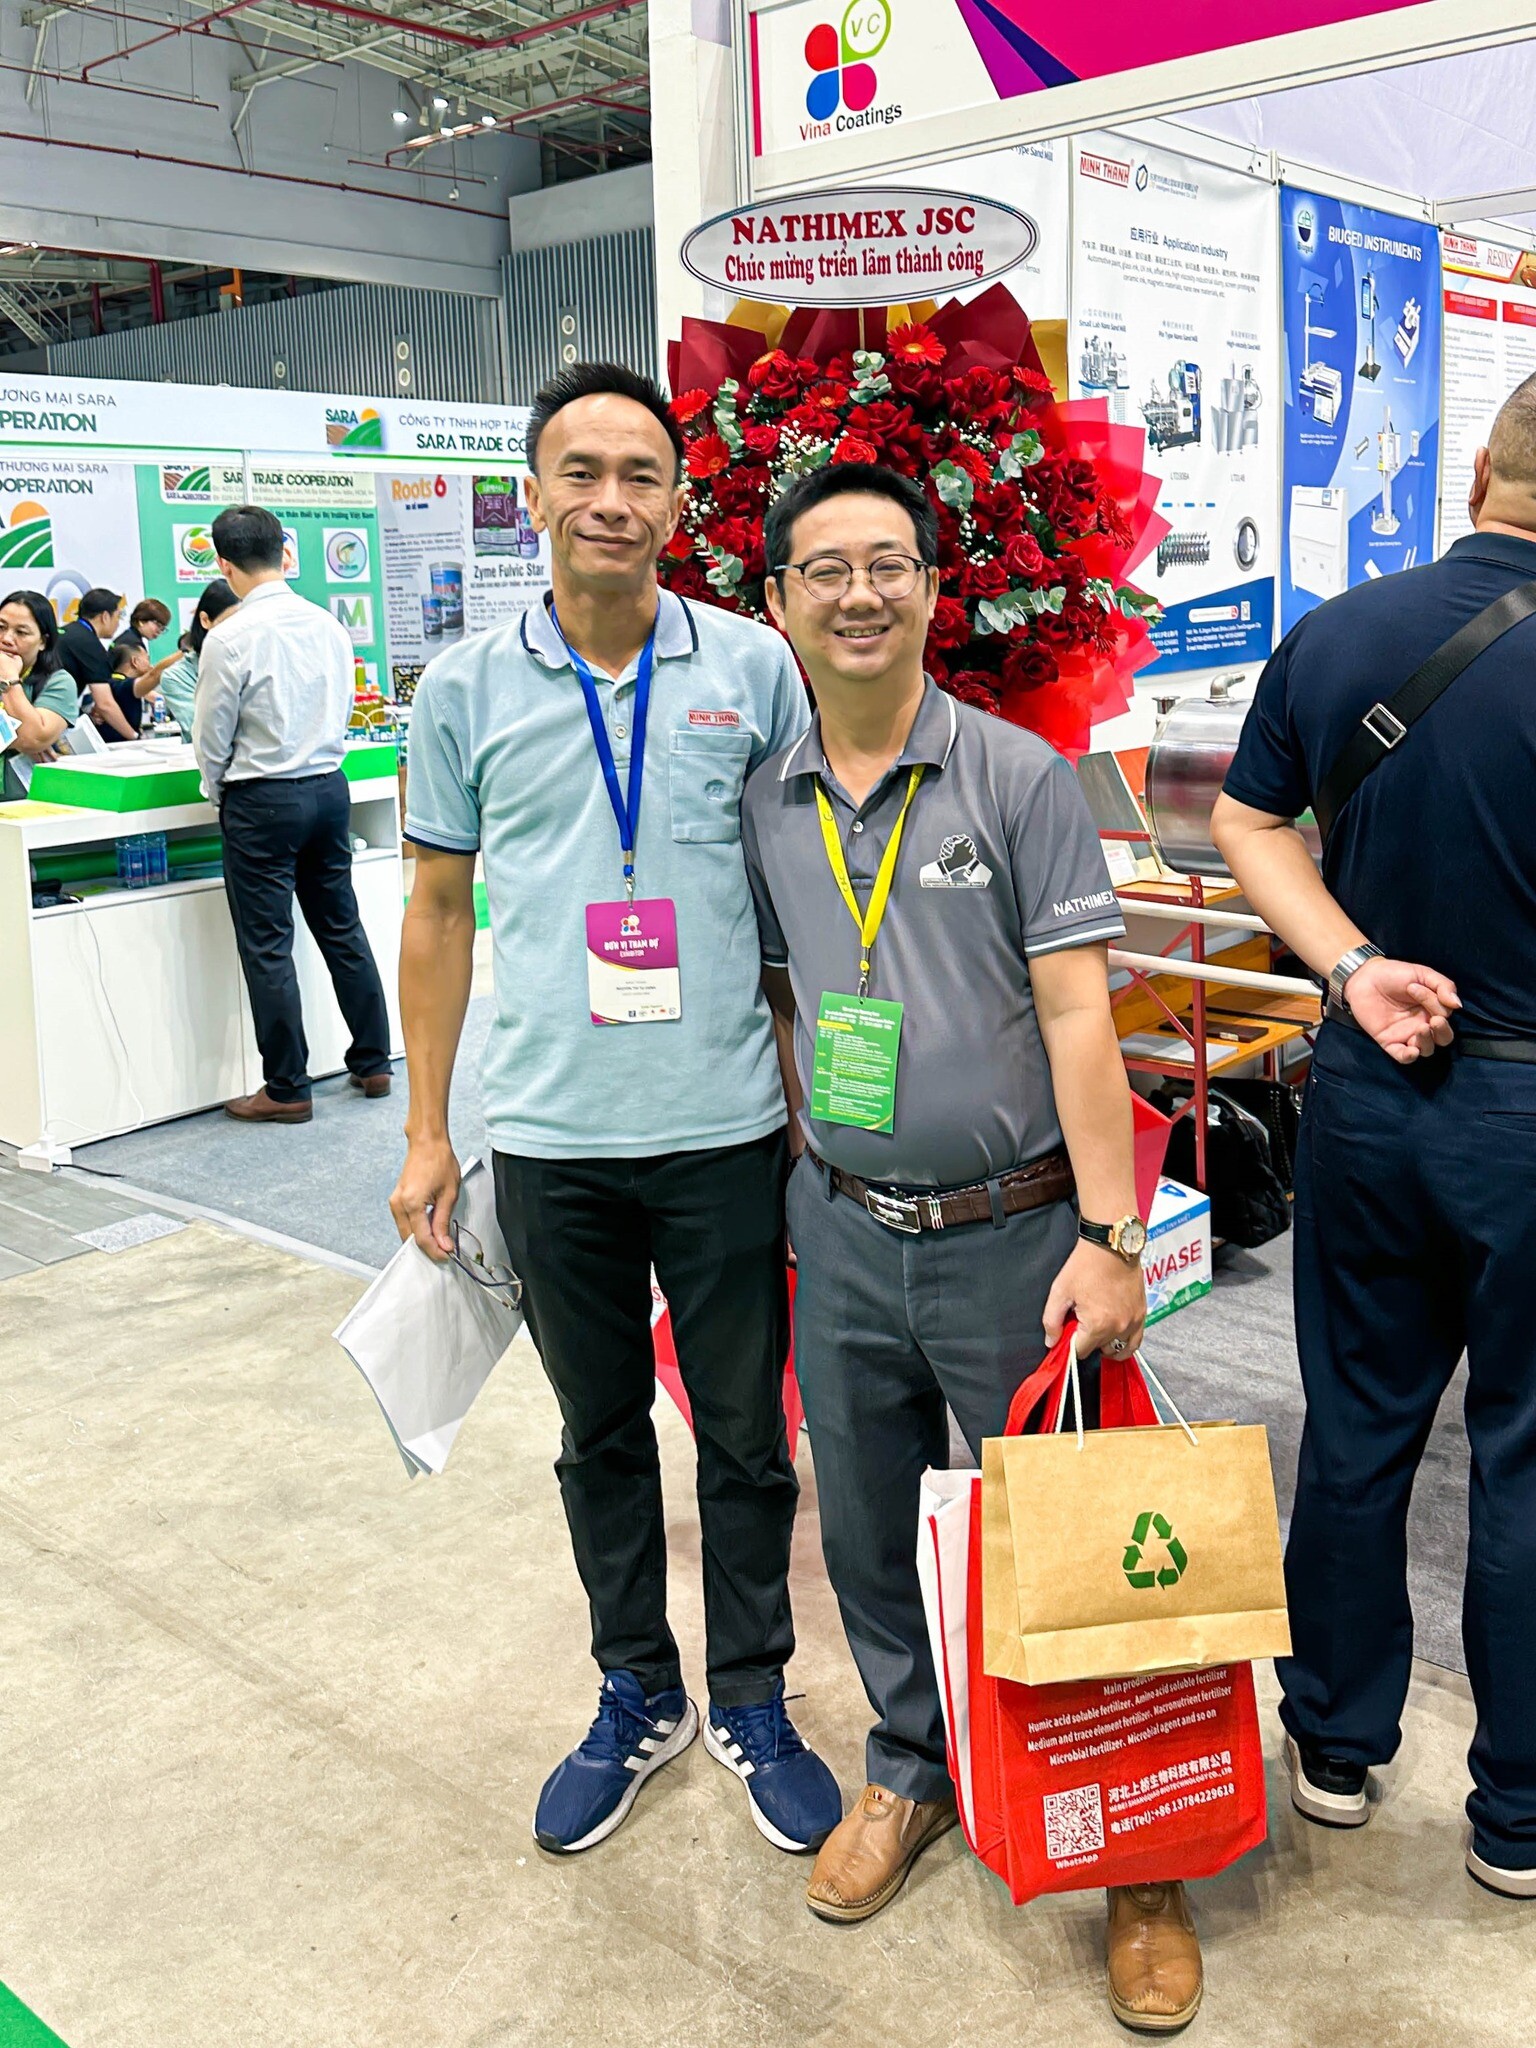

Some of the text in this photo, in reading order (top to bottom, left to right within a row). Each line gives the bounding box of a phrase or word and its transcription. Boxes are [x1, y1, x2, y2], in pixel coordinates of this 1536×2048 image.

[799, 103, 903, 142] Vina Coatings
[1081, 156, 1100, 175] MINH
[1103, 164, 1129, 184] THANH
[731, 206, 976, 245] NATHIMEX JSC
[1163, 235, 1200, 253] Application
[1328, 225, 1422, 262] BIUGED INSTRUMENTS
[725, 240, 984, 285] Chúc mừng triển lãm thành công
[1487, 248, 1514, 269] RESINS
[45, 391, 73, 407] MẠI
[77, 393, 117, 408] SARA
[326, 408, 359, 425] SARA
[399, 412, 524, 432] CÔNG TY TNHH HỢP TÁC
[417, 433, 457, 451] SARA
[460, 435, 503, 452] TRADE
[52, 462, 74, 475] MẠI
[77, 463, 109, 475] SARA
[223, 471, 354, 488] SAR TRADE COOPERATION
[391, 477, 433, 501] Roots
[434, 474, 447, 498] 6
[474, 563, 544, 580] Zyme Fulvic Star
[1053, 890, 1117, 917] NATHIMEX
[1145, 1239, 1202, 1285] WASE
[1028, 1718, 1053, 1733] Humic
[1054, 1714, 1071, 1727] acid
[1072, 1707, 1099, 1723] soluble
[1169, 1676, 1195, 1692] soluble
[1196, 1669, 1227, 1684] fertilizer
[1103, 1682, 1122, 1696] Main
[1027, 1738, 1058, 1752] Medium
[1058, 1732, 1073, 1744] and
[1074, 1728, 1093, 1742] trace
[1093, 1720, 1122, 1736] element
[1201, 1686, 1232, 1702] fertilizer
[1049, 1747, 1089, 1767] Microbial
[1127, 1723, 1160, 1745] Microbial
[1160, 1717, 1181, 1734] agent
[1181, 1711, 1196, 1726] and
[1196, 1712, 1206, 1722] so
[1206, 1708, 1217, 1719] on
[1108, 1750, 1232, 1804] 河北上桥生物科技有限公司
[1172, 1782, 1235, 1811] 13784229618
[1055, 1853, 1099, 1870] WhatsApp
